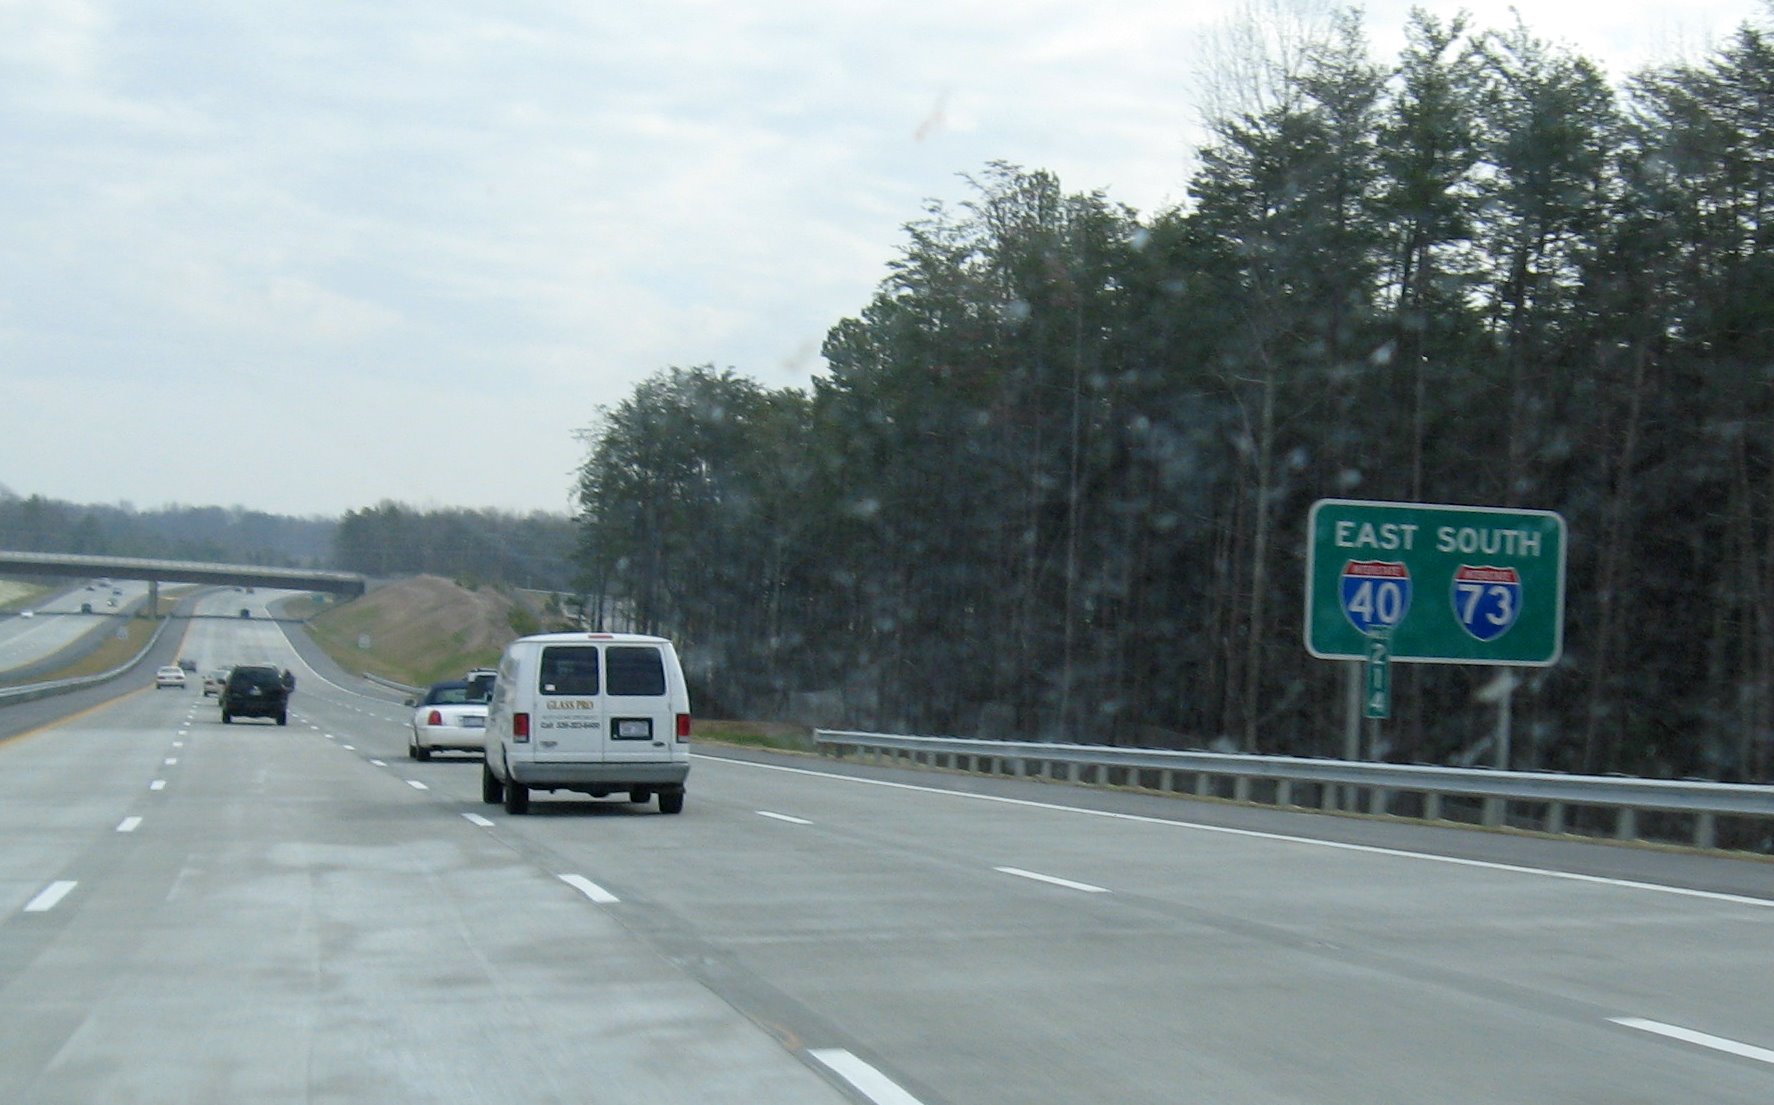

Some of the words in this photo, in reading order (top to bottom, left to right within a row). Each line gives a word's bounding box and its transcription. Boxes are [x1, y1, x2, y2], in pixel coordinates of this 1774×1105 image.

[1335, 520, 1419, 551] EAST
[1436, 526, 1542, 557] SOUTH
[1347, 581, 1403, 625] 40
[1458, 584, 1514, 626] 73
[546, 700, 575, 710] GLASS
[575, 700, 594, 710] PRO
